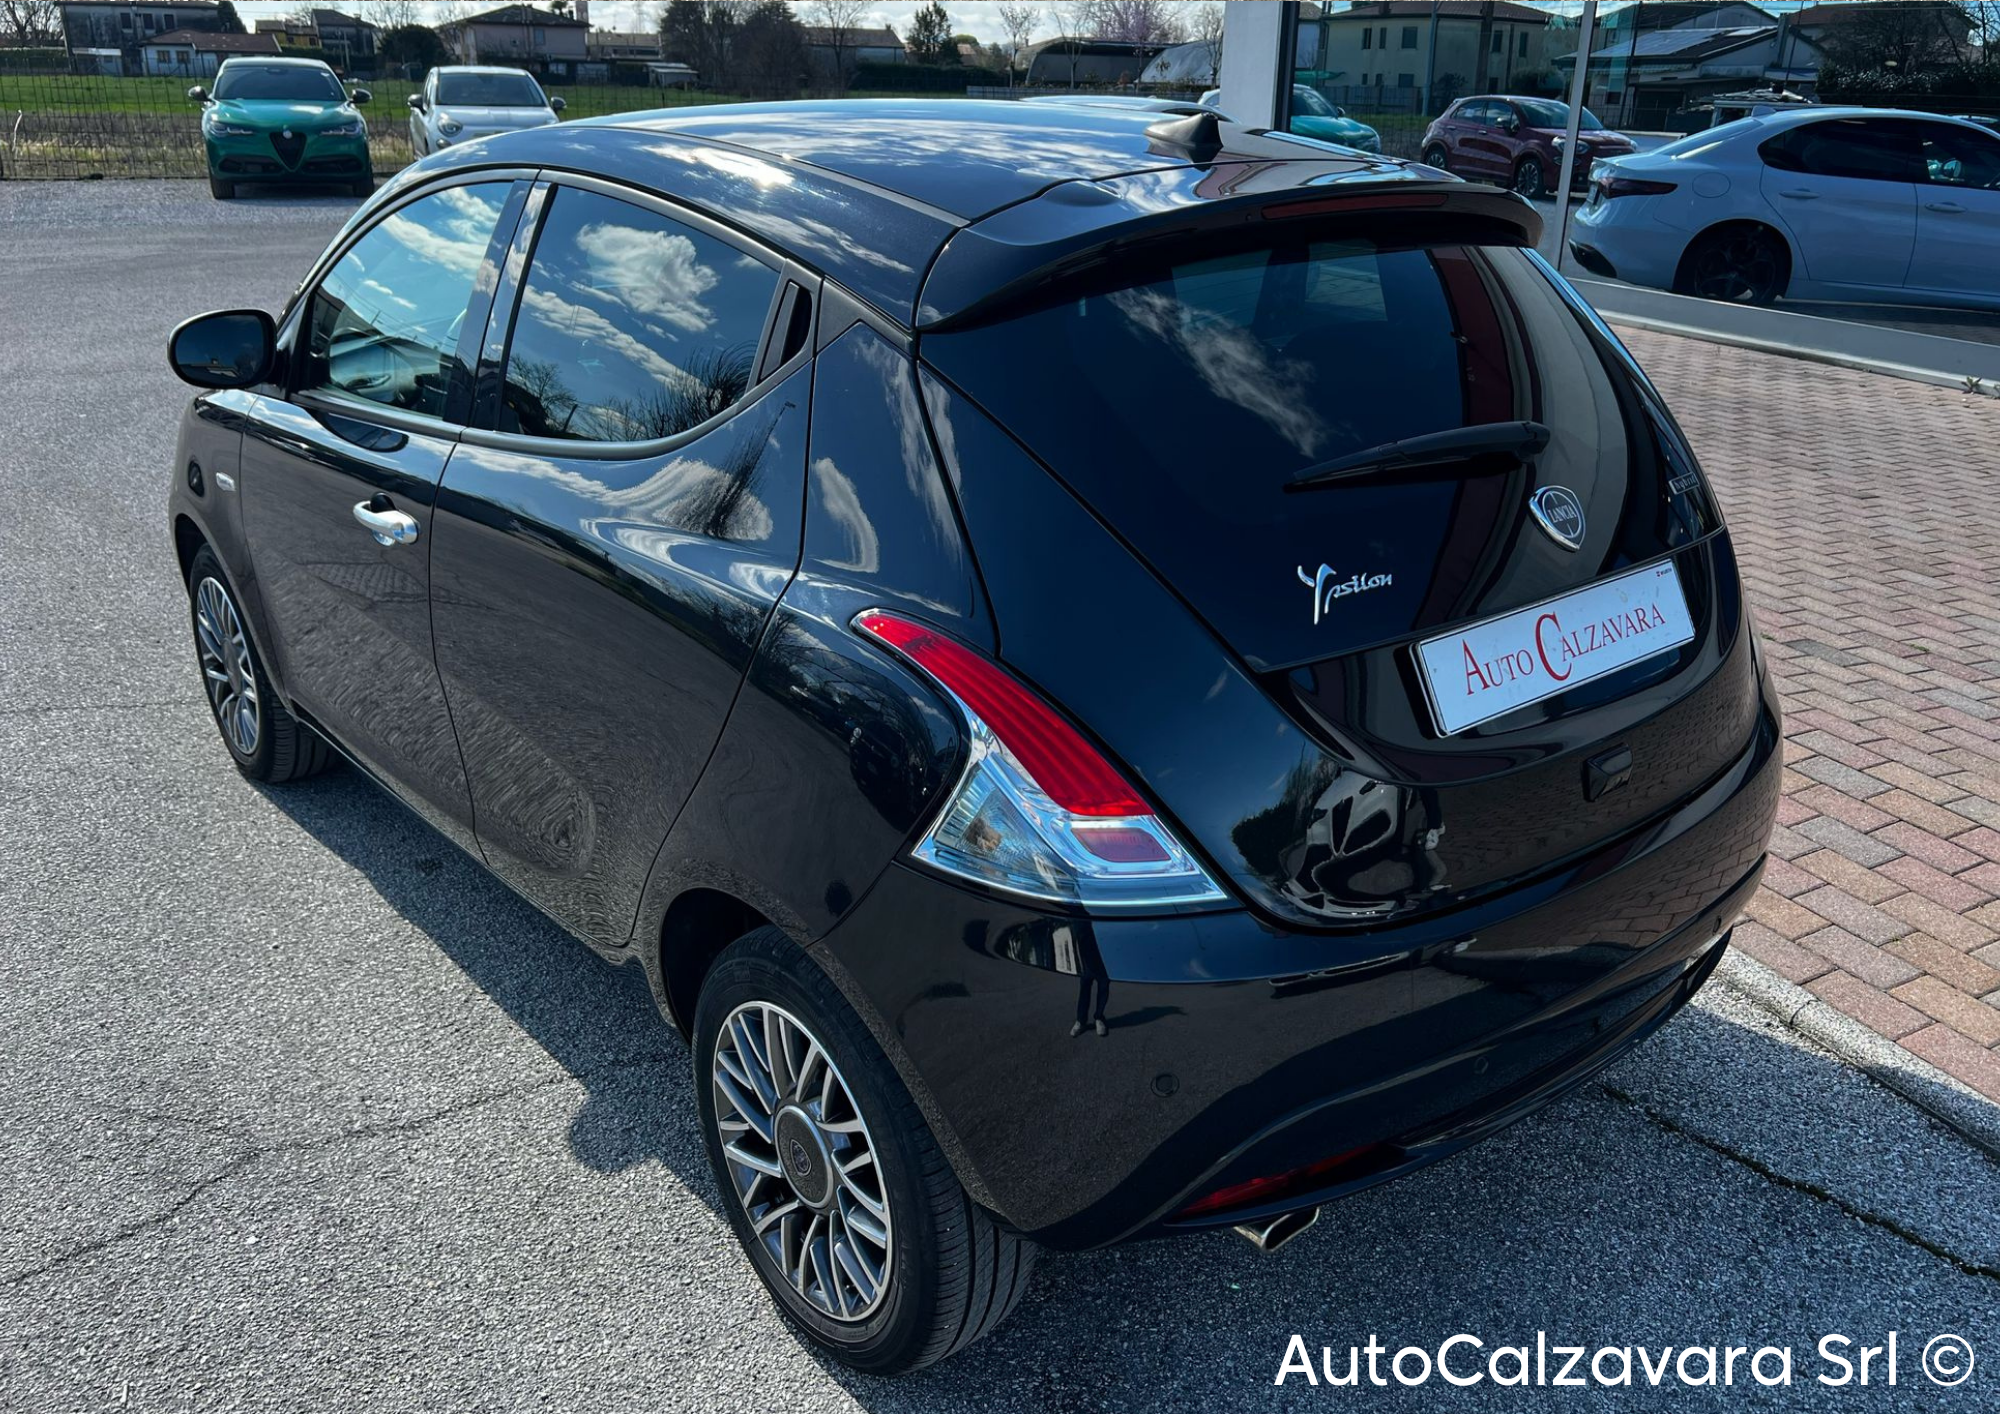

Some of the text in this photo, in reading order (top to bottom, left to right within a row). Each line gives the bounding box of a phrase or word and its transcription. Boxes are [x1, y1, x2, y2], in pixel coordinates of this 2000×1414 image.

[1548, 504, 1577, 523] LANCIA
[1297, 563, 1392, 625] Ypsilon
[1535, 603, 1666, 681] CALZAVARA
